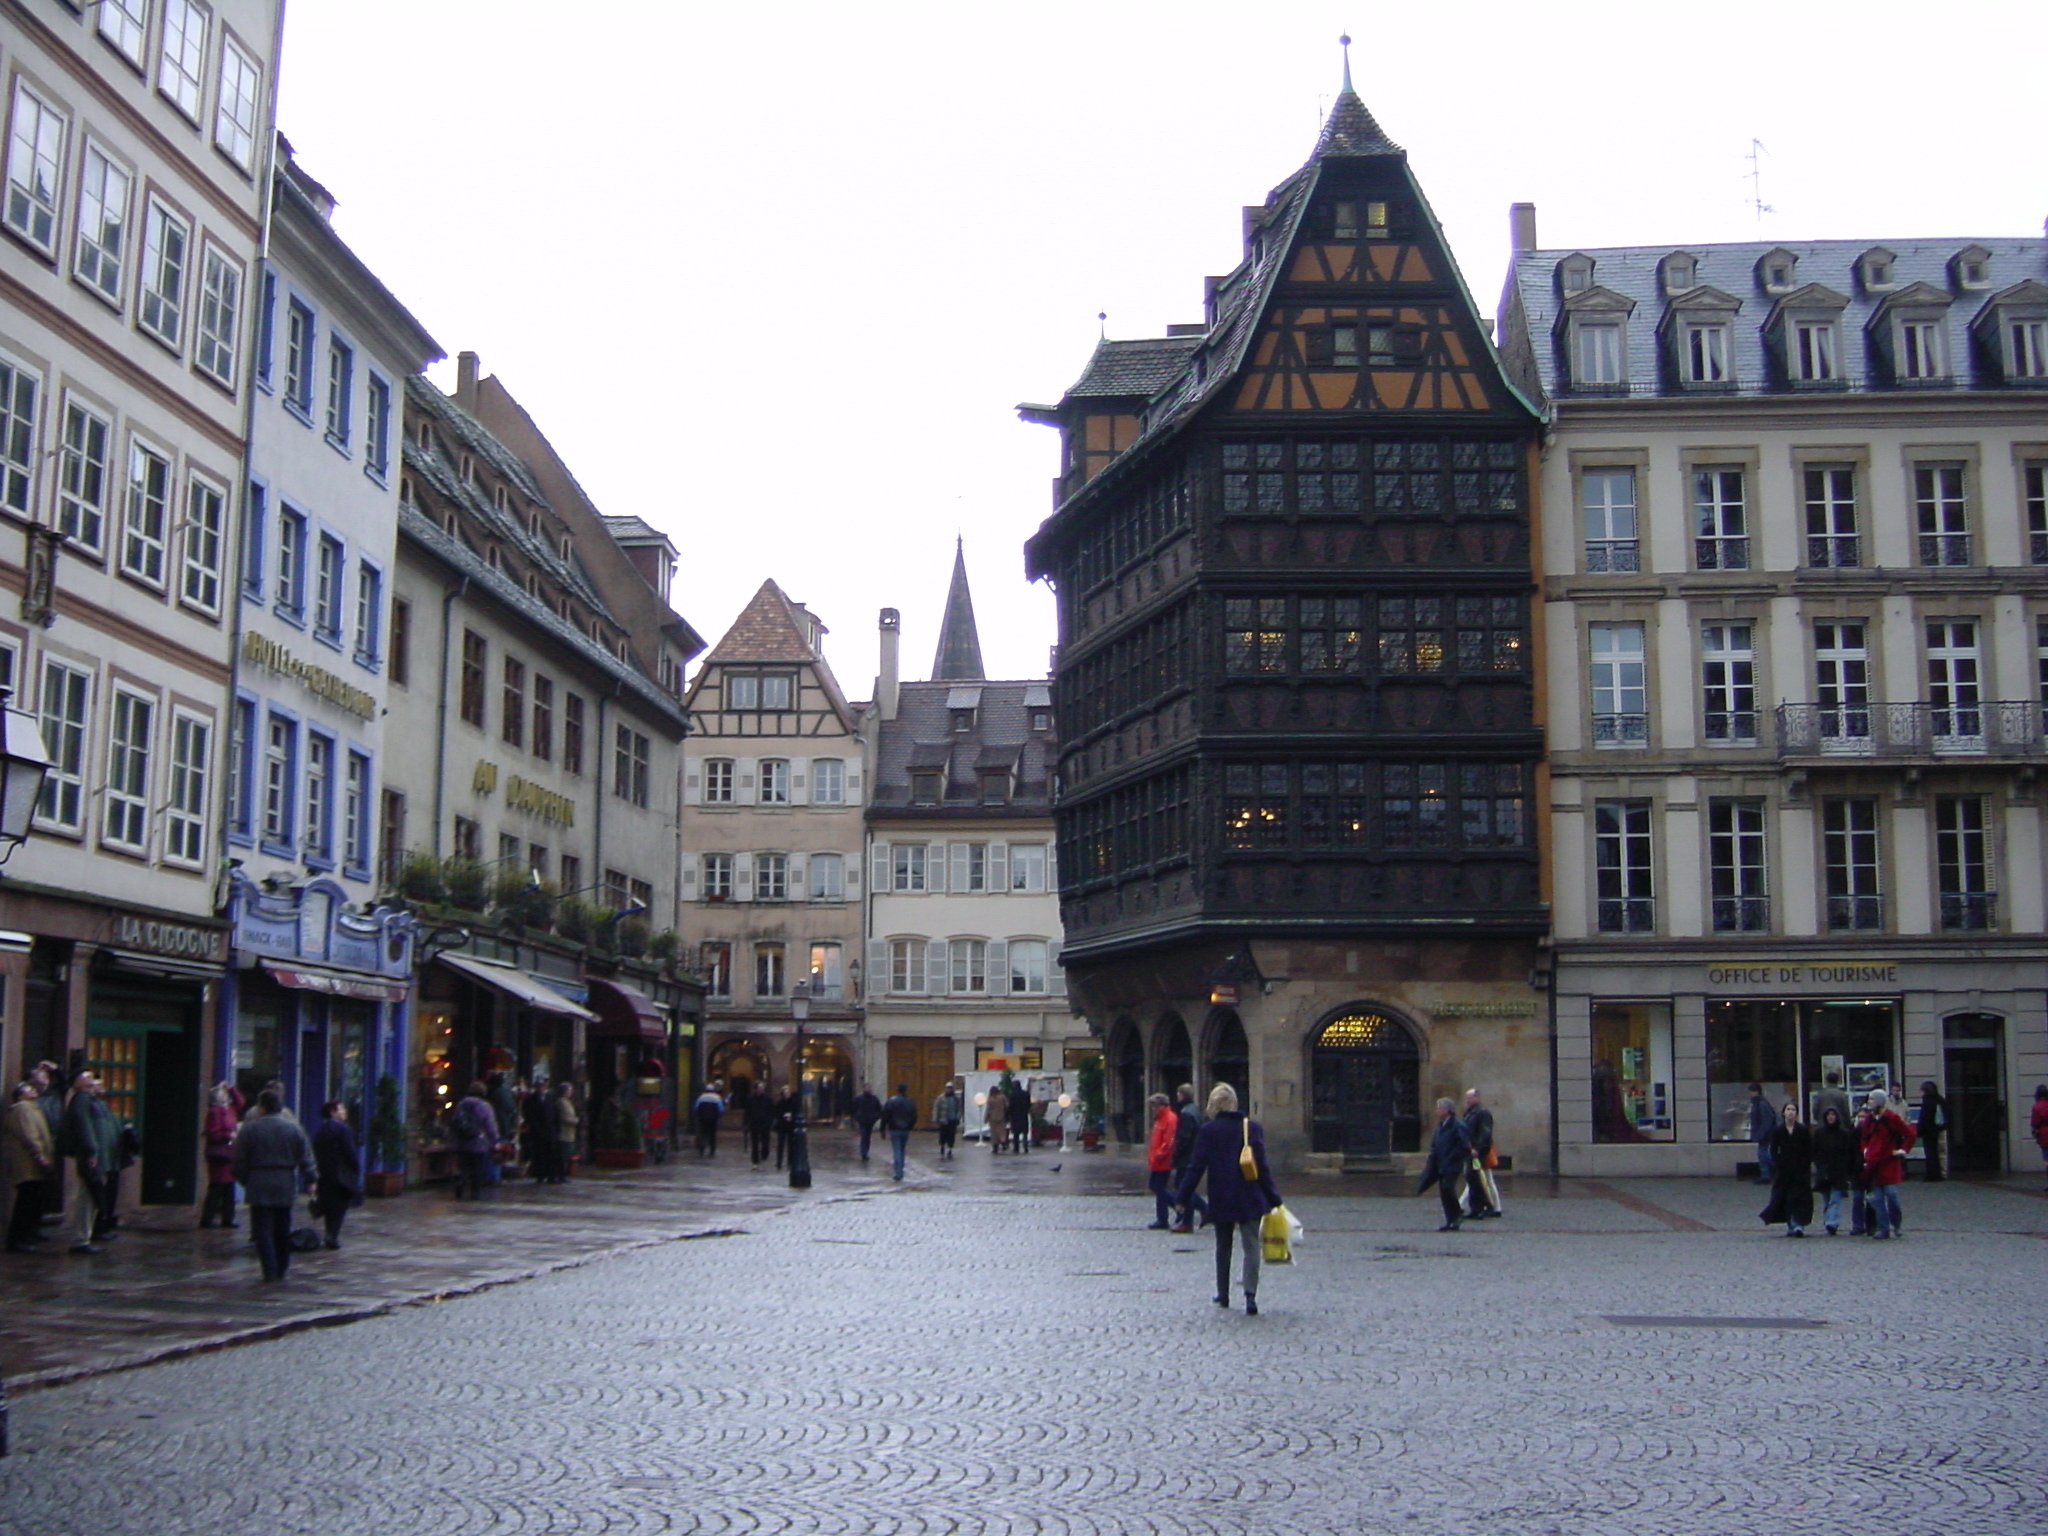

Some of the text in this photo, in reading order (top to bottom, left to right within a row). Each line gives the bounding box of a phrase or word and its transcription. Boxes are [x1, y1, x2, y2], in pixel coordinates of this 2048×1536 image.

[122, 916, 140, 943] LA
[1709, 966, 1898, 984] OFFICE DE TOURISME
